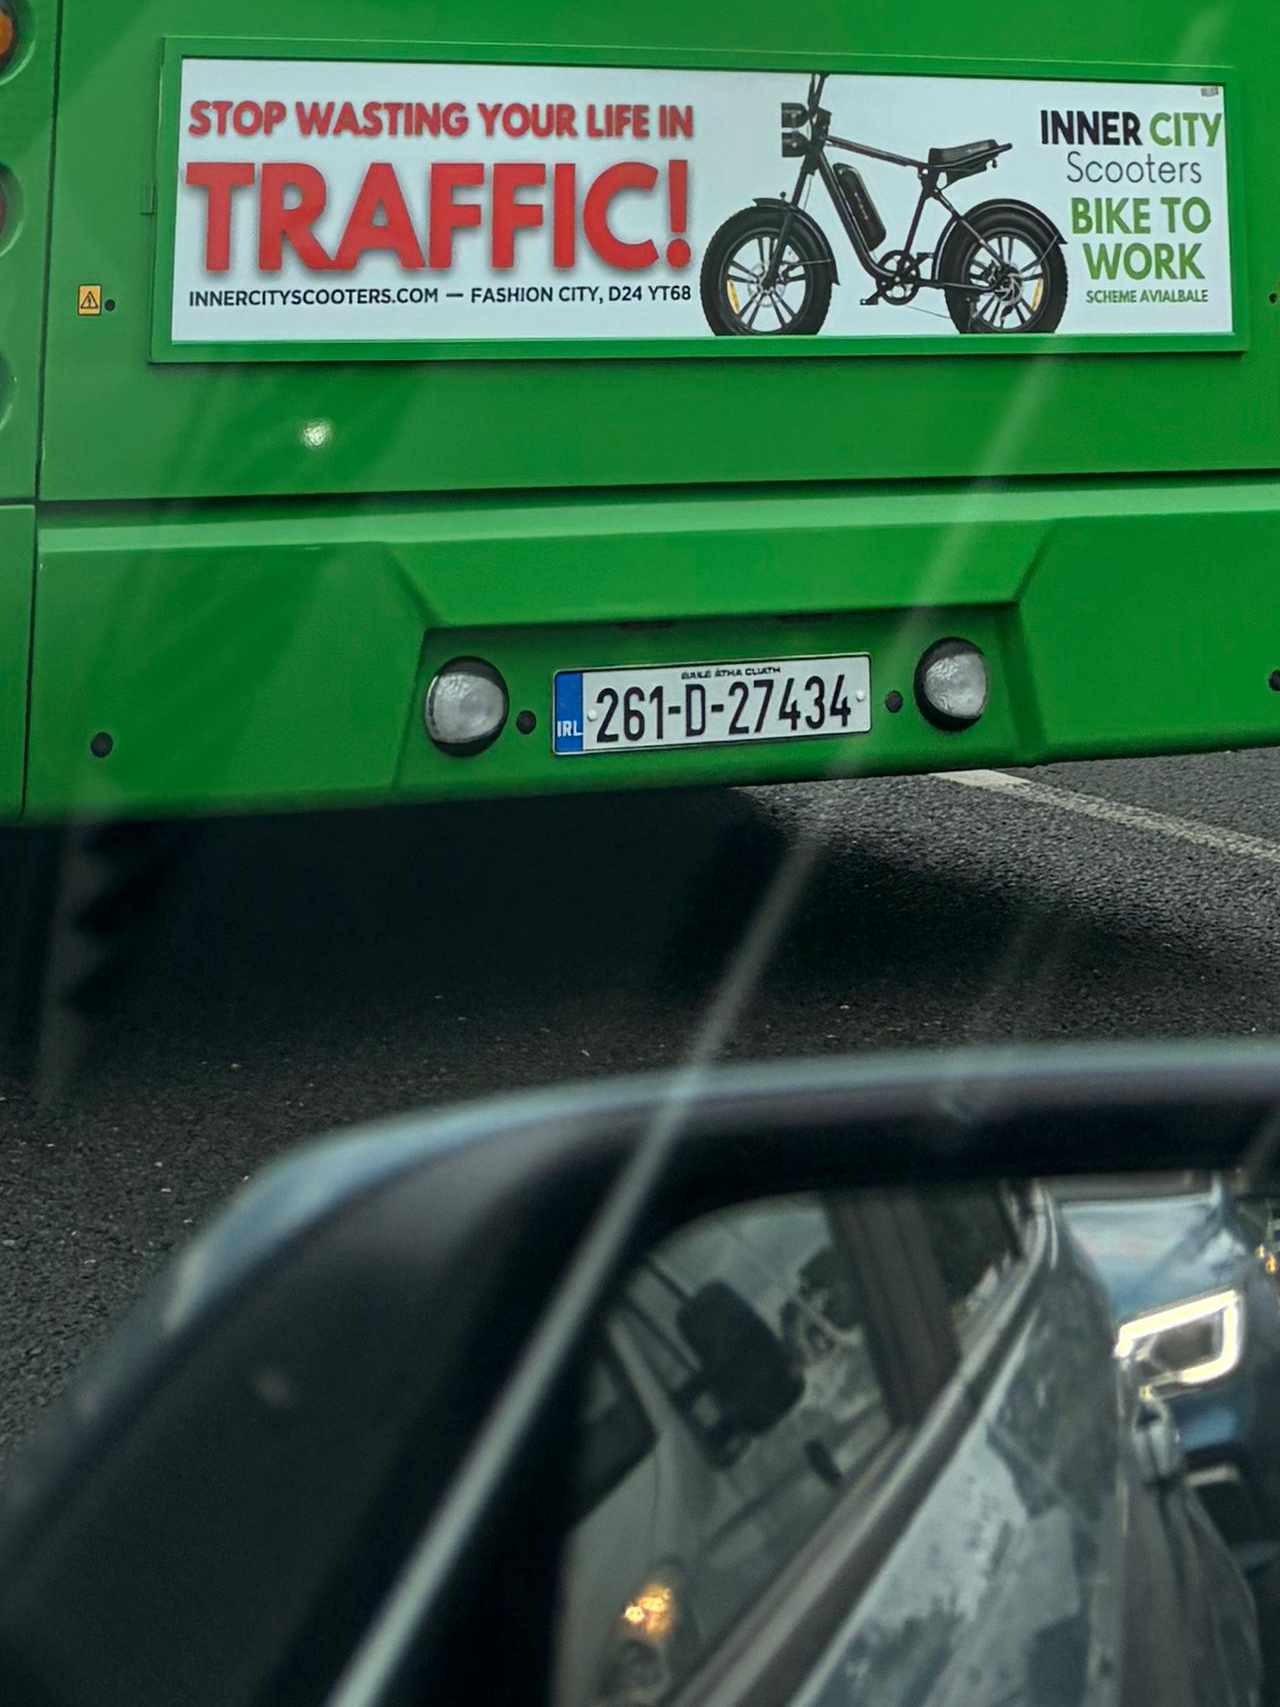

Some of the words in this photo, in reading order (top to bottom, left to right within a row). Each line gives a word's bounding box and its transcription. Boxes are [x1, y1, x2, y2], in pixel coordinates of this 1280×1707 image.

[188, 100, 287, 136] STOP
[295, 101, 469, 137] WASTING
[478, 102, 577, 137] YOUR
[586, 104, 650, 138] LIFE
[659, 105, 694, 138] IN
[1040, 110, 1143, 146] INNER
[1149, 112, 1222, 147] CITY
[1067, 151, 1202, 184] Scooters
[185, 159, 692, 271] TRAFFIC!
[1071, 197, 1151, 234] BIKE
[1160, 196, 1212, 234] TO
[1082, 242, 1205, 281] WORK
[188, 288, 439, 307] INNERCITYSCOOTERS.COM
[471, 287, 554, 304] FASHION
[559, 286, 604, 305] CITY,
[608, 286, 643, 302] D24
[648, 285, 692, 302] YT68
[1086, 289, 1138, 304] SCHEME
[596, 674, 852, 744] 261-D-27434
[556, 719, 584, 737] IRL
